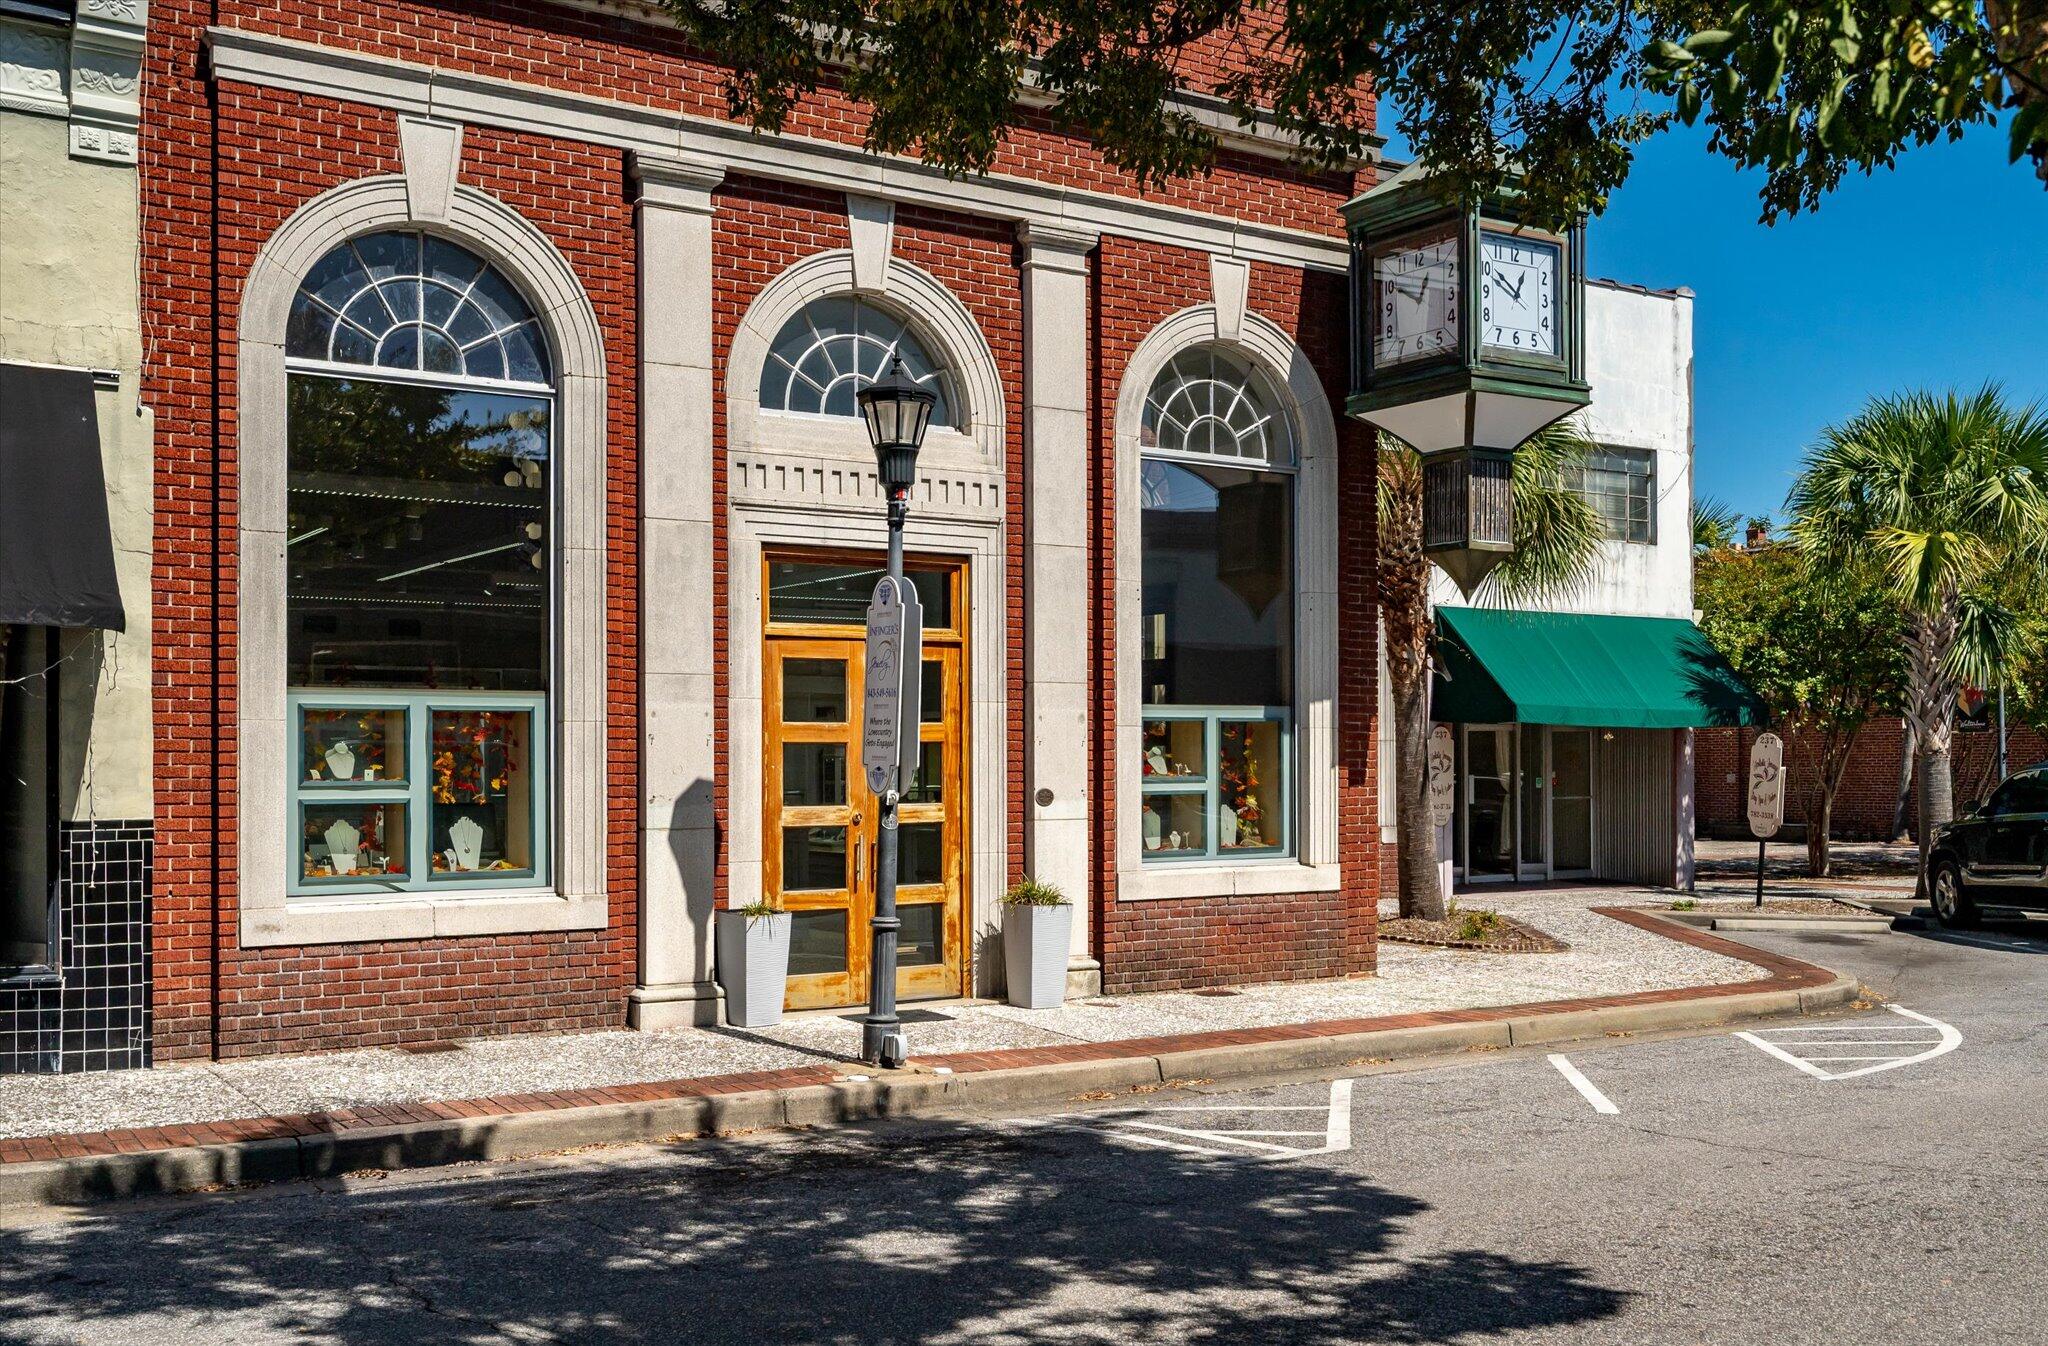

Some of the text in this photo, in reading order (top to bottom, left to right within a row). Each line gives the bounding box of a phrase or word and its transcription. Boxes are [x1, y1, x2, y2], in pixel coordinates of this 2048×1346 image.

[1494, 244, 1502, 260] 11
[1510, 247, 1520, 263] 12
[1398, 257, 1406, 272] 11
[1414, 252, 1425, 268] 12
[1448, 262, 1454, 278] 2
[1481, 260, 1491, 276] 10
[1541, 271, 1548, 286] 2
[1384, 280, 1395, 295] 10
[1447, 286, 1455, 301] 3
[1482, 284, 1490, 299] 9
[1541, 294, 1548, 309] 3
[1385, 302, 1393, 318] 9
[1447, 308, 1456, 324] 4
[1483, 307, 1490, 322] 8
[1541, 316, 1549, 331] 4
[1386, 324, 1393, 339] 8
[1435, 330, 1443, 346] 5
[1495, 327, 1502, 342] 7
[1512, 330, 1520, 345] 6
[1398, 339, 1406, 355] 7
[1416, 335, 1424, 350] 6
[1531, 333, 1538, 347] 5
[883, 717, 892, 726] the
[1759, 736, 1775, 745] 237
